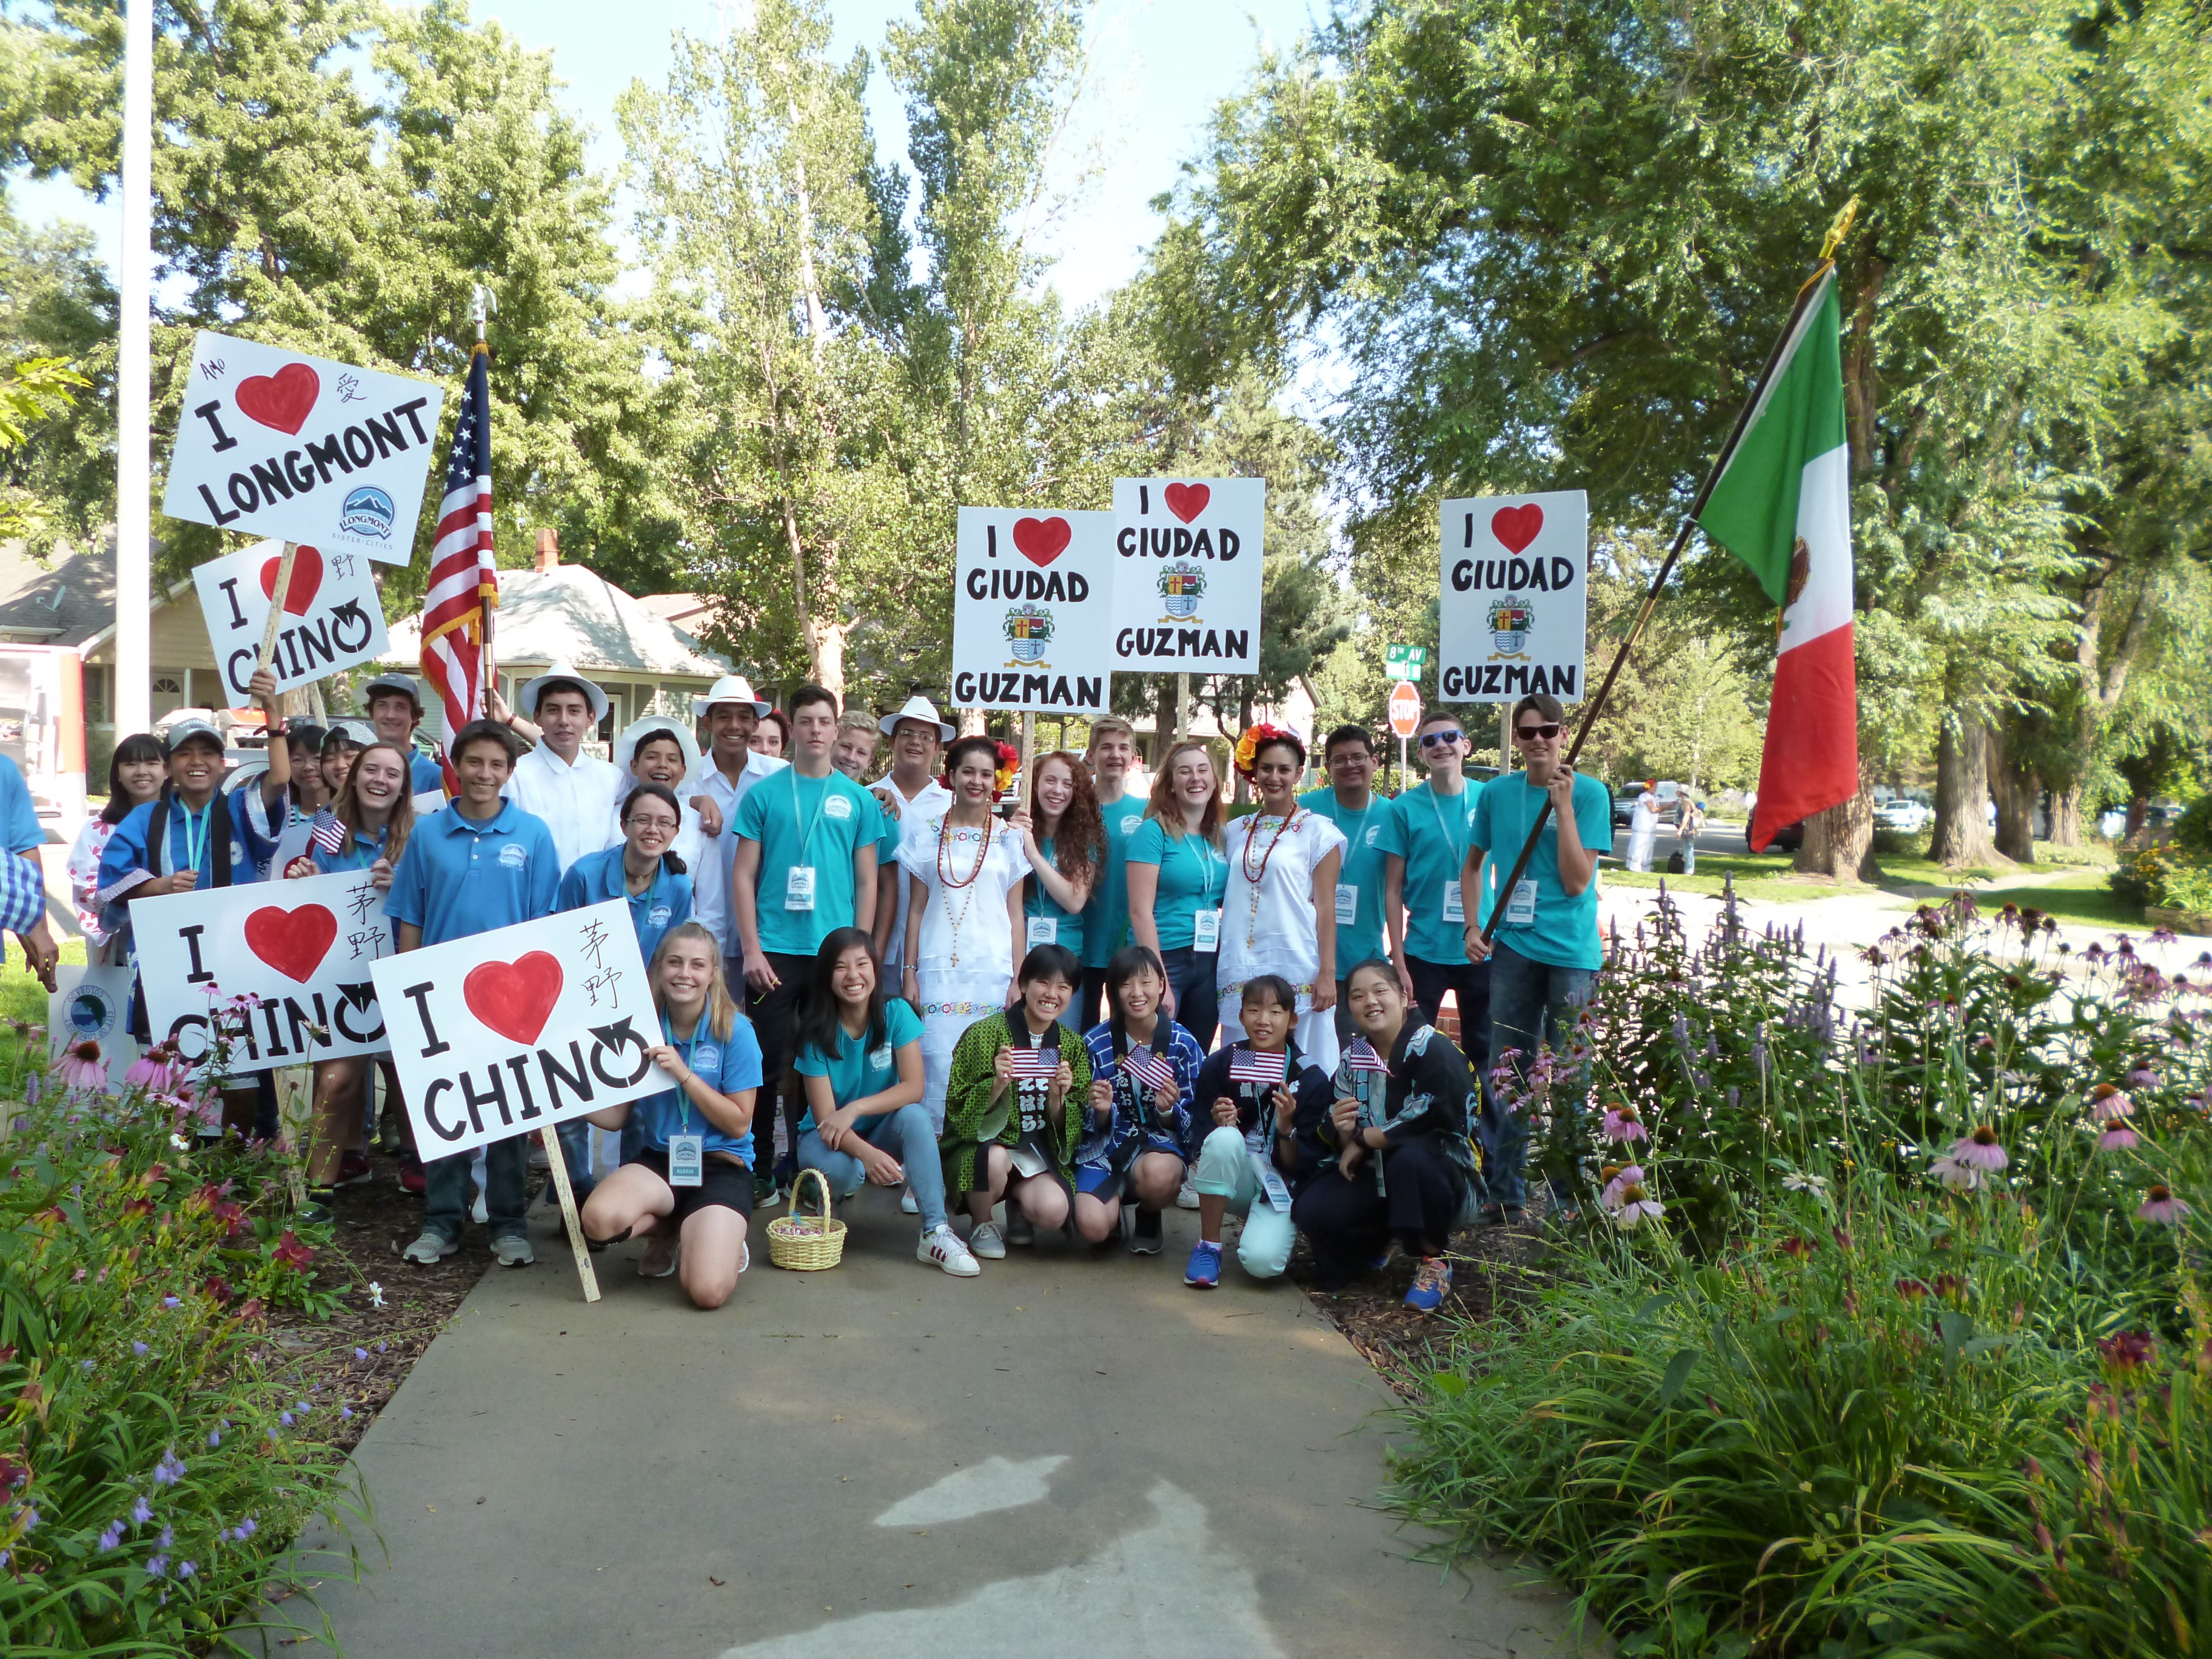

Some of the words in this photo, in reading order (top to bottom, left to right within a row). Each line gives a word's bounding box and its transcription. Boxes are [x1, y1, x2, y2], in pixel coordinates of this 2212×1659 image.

[200, 358, 225, 380] AMO
[337, 373, 368, 403] 愛
[195, 400, 238, 453] I
[197, 397, 430, 526] LONGMONT
[1139, 485, 1149, 515] I
[342, 515, 390, 534] LONGMONT
[1464, 513, 1473, 548] I
[987, 525, 997, 558] I
[219, 577, 248, 630] I
[1116, 627, 1249, 659] GUZMAN
[1408, 648, 1423, 662] AV
[954, 671, 1102, 708] GUZMAN
[1443, 665, 1577, 697] GUZMAN
[1392, 699, 1418, 721] STOP
[179, 924, 214, 984] I
[67, 987, 104, 1003] COLORADO
[65, 1019, 96, 1041] LONGONT
[106, 1011, 114, 1027] CITY
[403, 980, 450, 1059] I
[424, 1014, 652, 1141] CHINO
